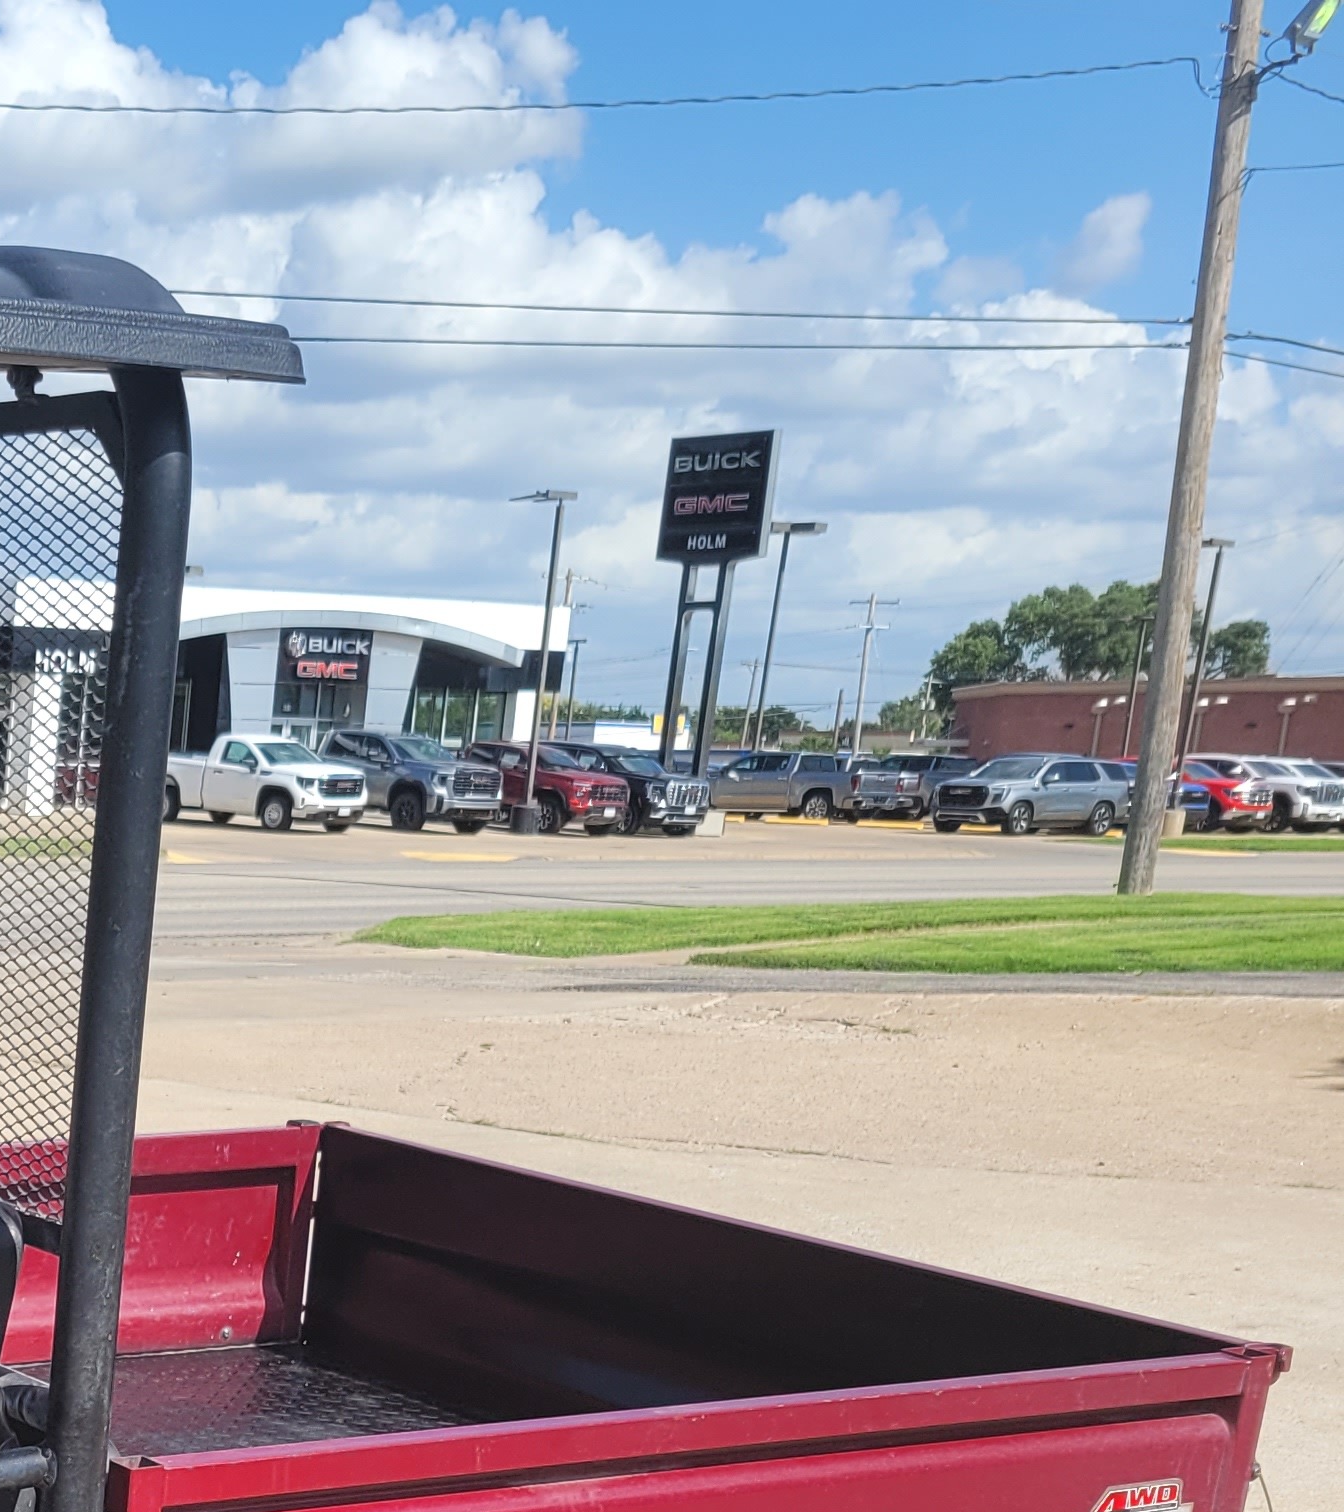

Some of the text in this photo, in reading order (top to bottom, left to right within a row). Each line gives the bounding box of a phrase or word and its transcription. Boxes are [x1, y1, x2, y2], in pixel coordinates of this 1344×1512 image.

[674, 450, 761, 474] BUICK
[674, 492, 750, 516] GMC
[686, 533, 727, 551] HOLM
[307, 636, 370, 655] BUICK
[295, 660, 359, 680] GMC
